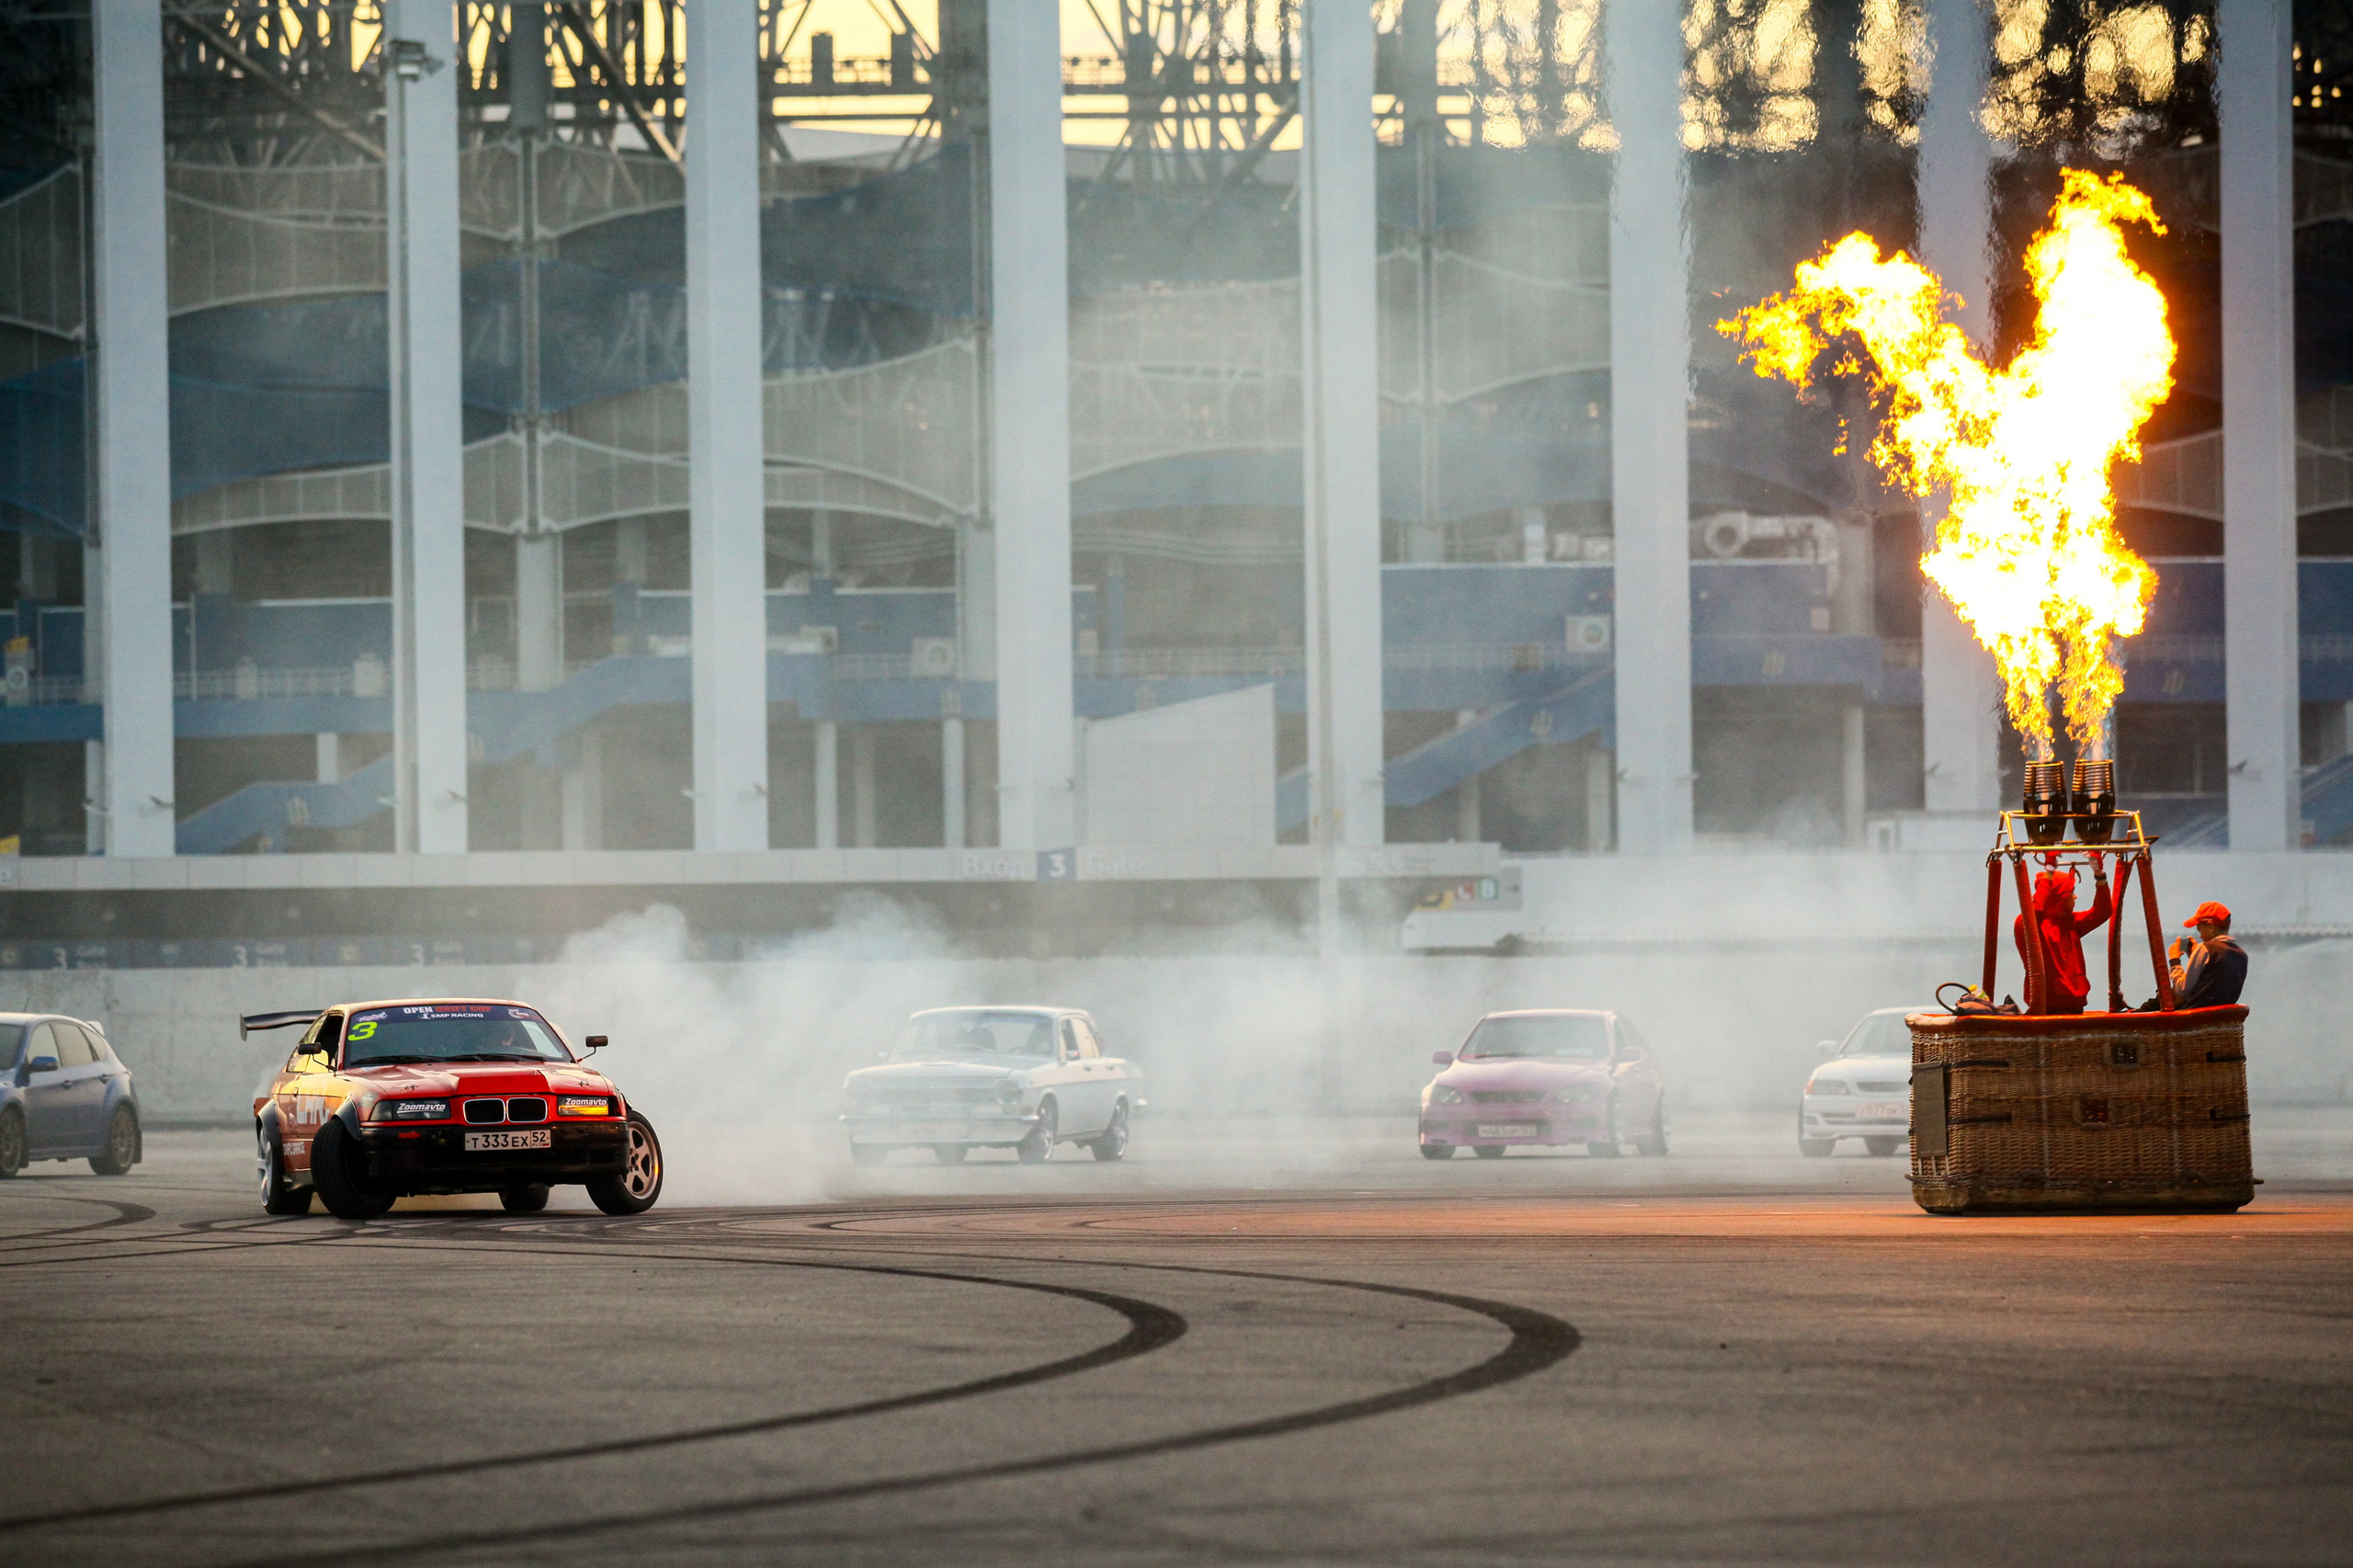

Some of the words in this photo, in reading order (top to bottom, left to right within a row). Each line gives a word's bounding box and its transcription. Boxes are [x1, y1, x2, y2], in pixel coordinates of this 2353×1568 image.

[1048, 853, 1067, 878] 3
[347, 1021, 378, 1041] 3
[565, 1097, 607, 1106] Zoomavto
